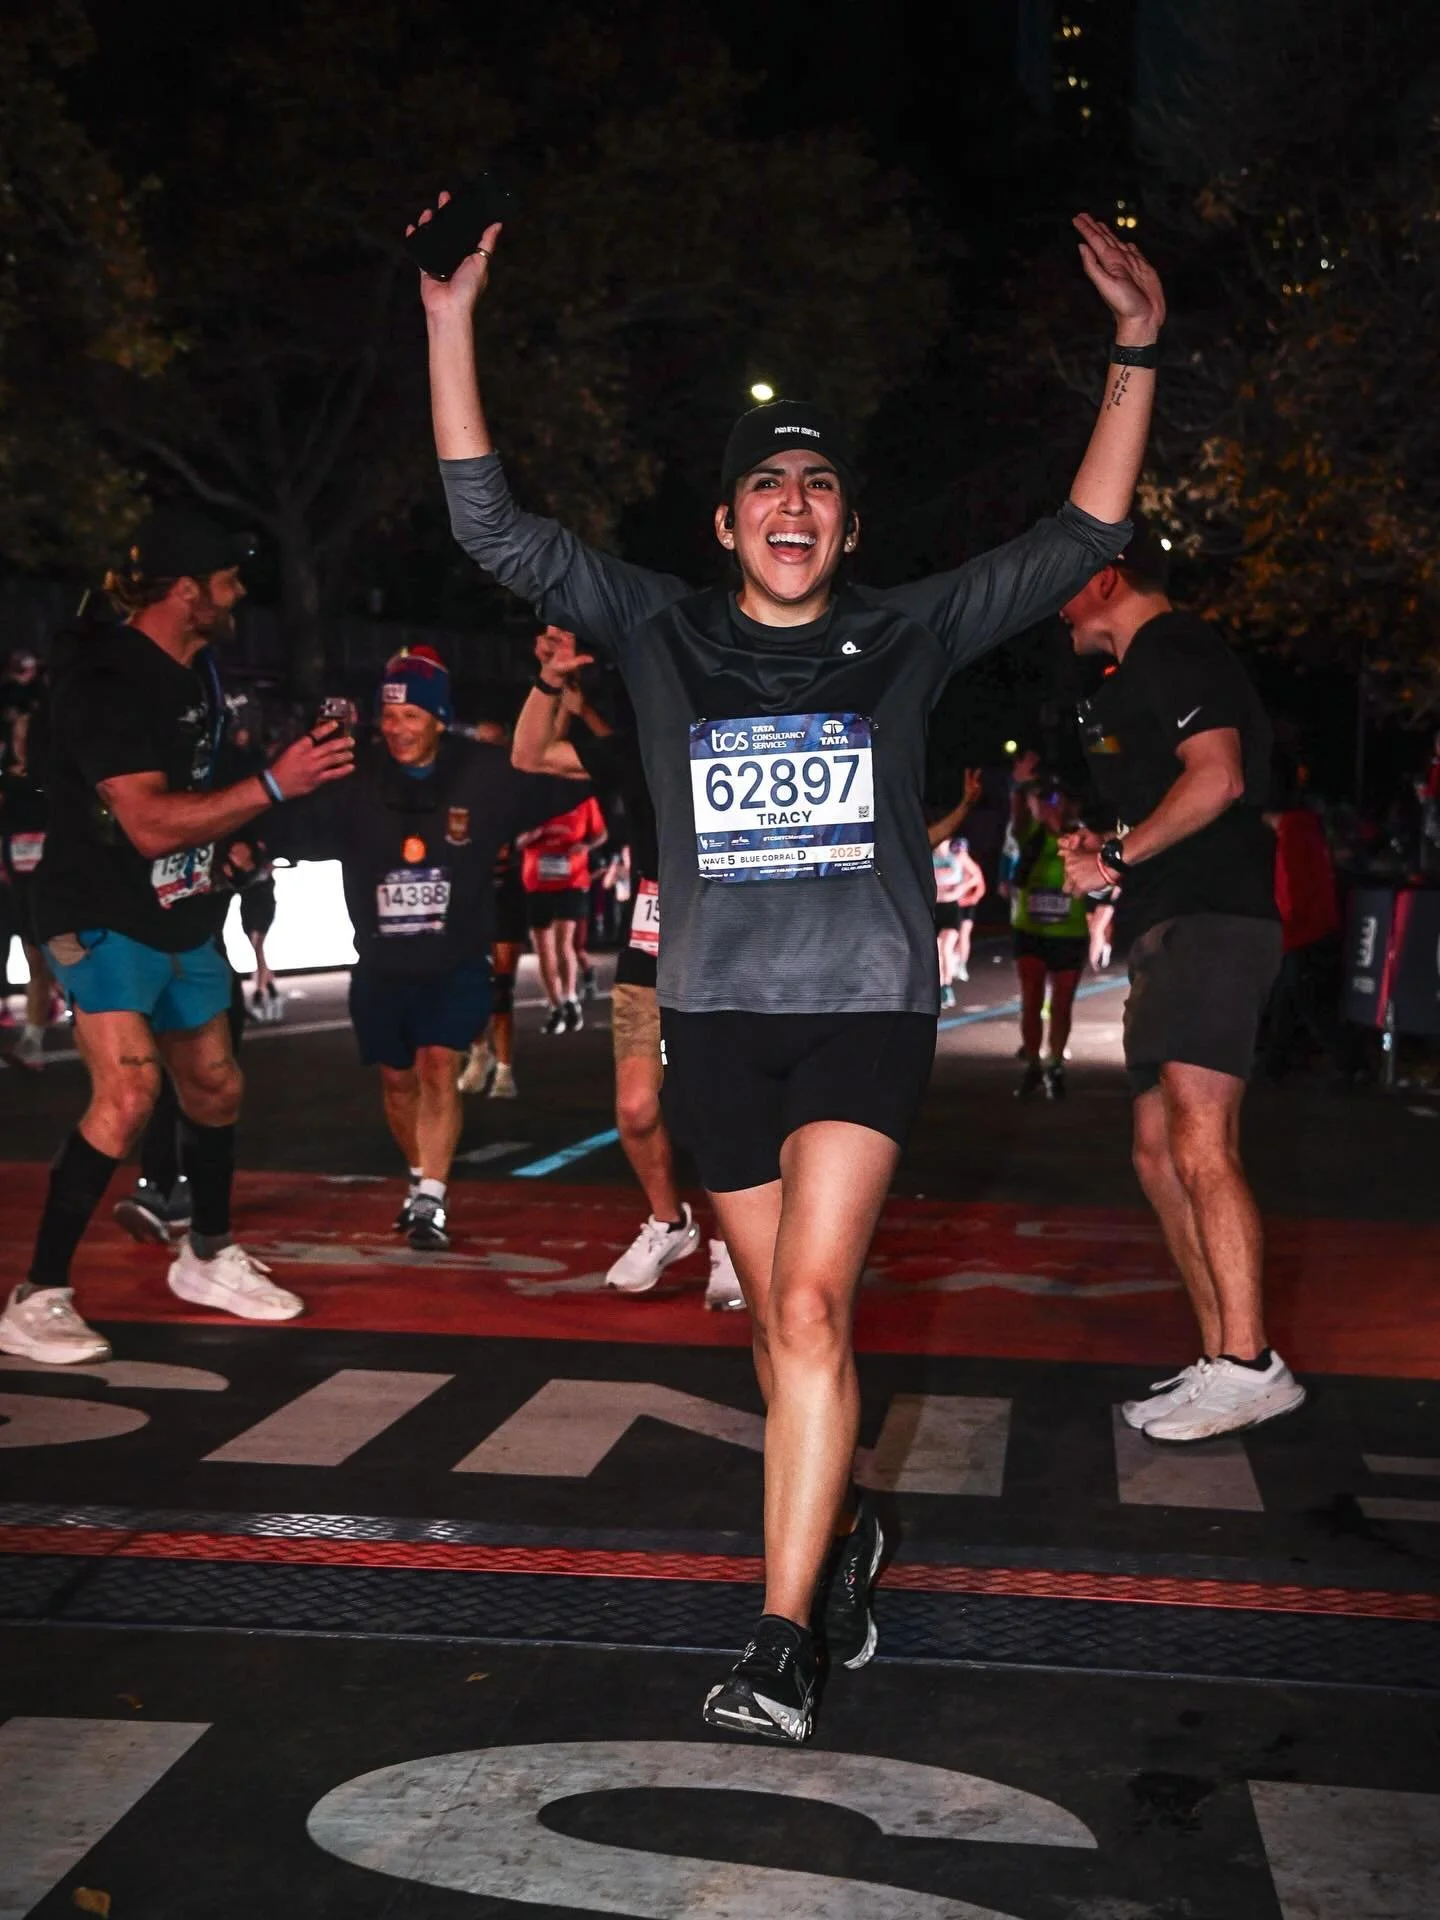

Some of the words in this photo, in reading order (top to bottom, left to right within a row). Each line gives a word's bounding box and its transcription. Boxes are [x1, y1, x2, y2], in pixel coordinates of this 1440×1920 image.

[752, 725, 775, 733] TATA
[752, 731, 806, 741] CONSULTANCY
[711, 729, 749, 752] tcs
[752, 741, 787, 750] SERVICES
[819, 735, 849, 745] TATA
[706, 754, 859, 812] 62897
[757, 810, 812, 826] TRACY
[702, 857, 725, 865] WAVE
[727, 855, 736, 865] 5
[740, 855, 760, 863] BLUE
[761, 853, 795, 861] CORRAL
[797, 850, 806, 861] D
[830, 847, 862, 859] 2025
[381, 884, 447, 907] 14388
